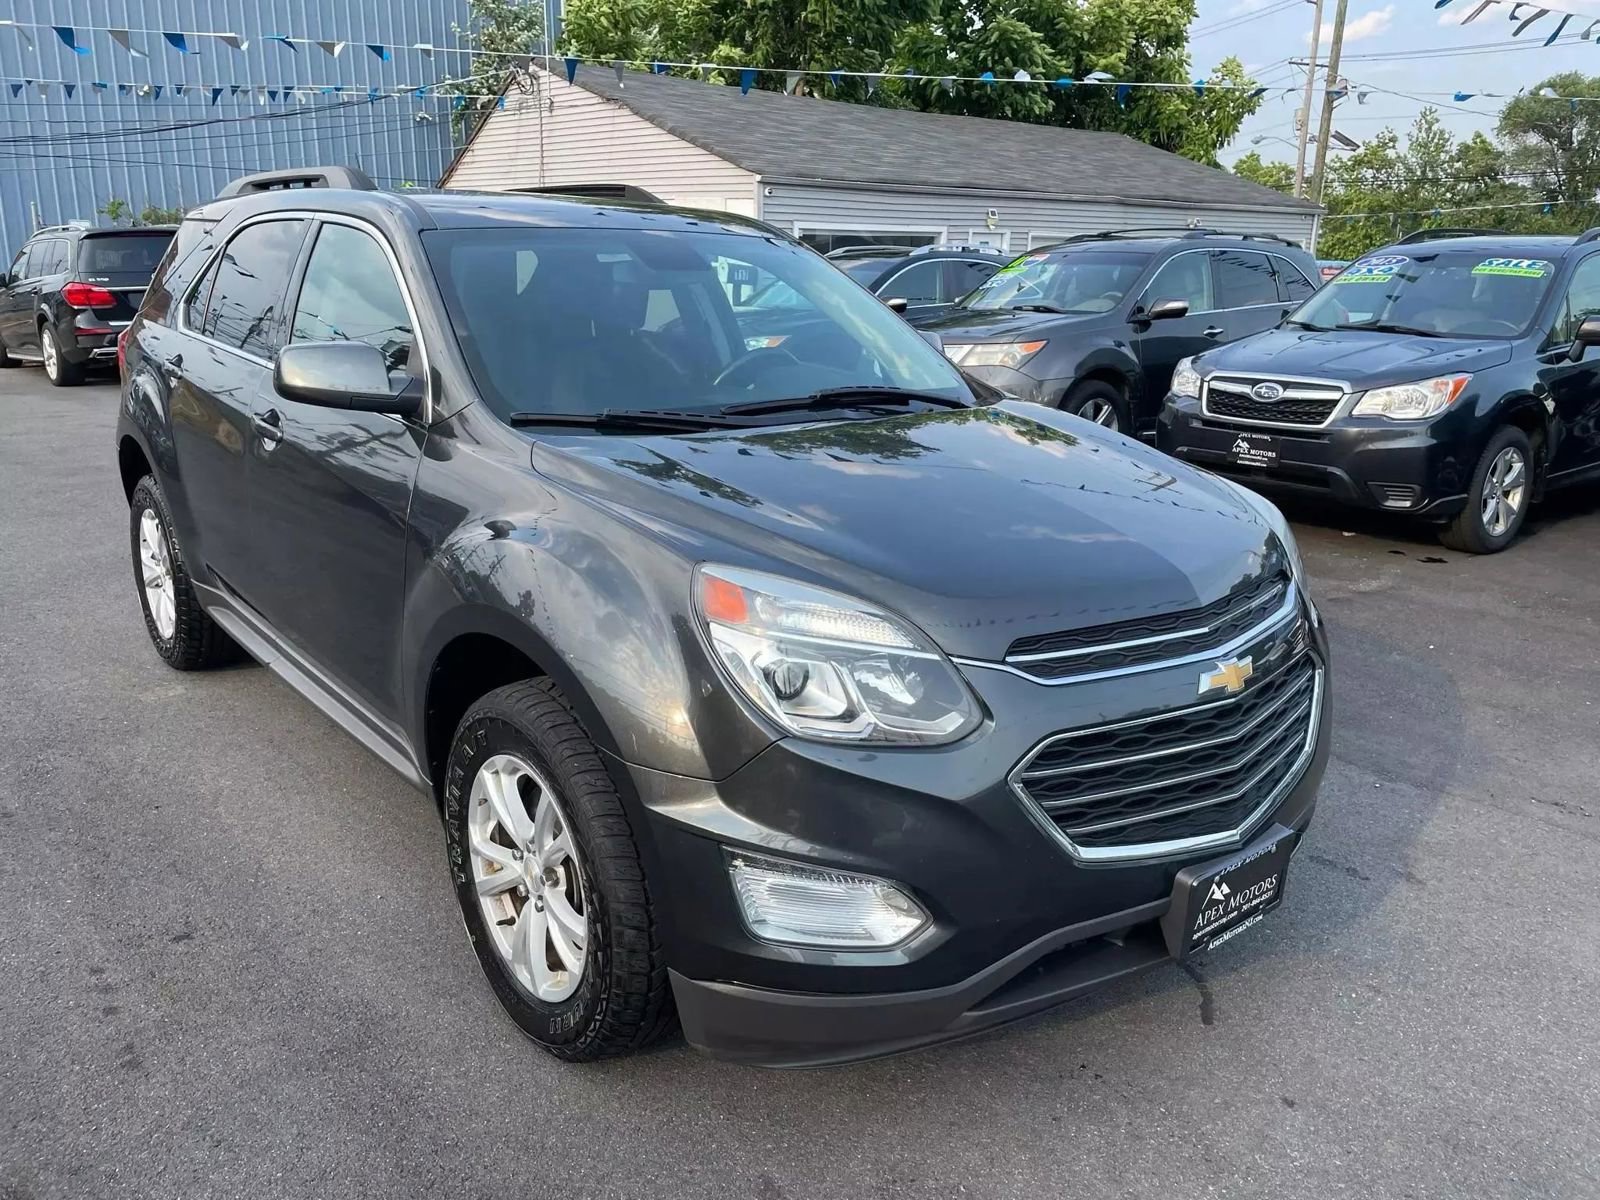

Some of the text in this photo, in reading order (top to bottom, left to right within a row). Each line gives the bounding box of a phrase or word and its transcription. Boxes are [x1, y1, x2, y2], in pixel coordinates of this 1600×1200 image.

[1479, 257, 1548, 269] SALE
[1250, 449, 1276, 458] MOTORS
[1219, 842, 1277, 876] APEX MOTORS
[1193, 873, 1278, 930] APEX MOTORS
